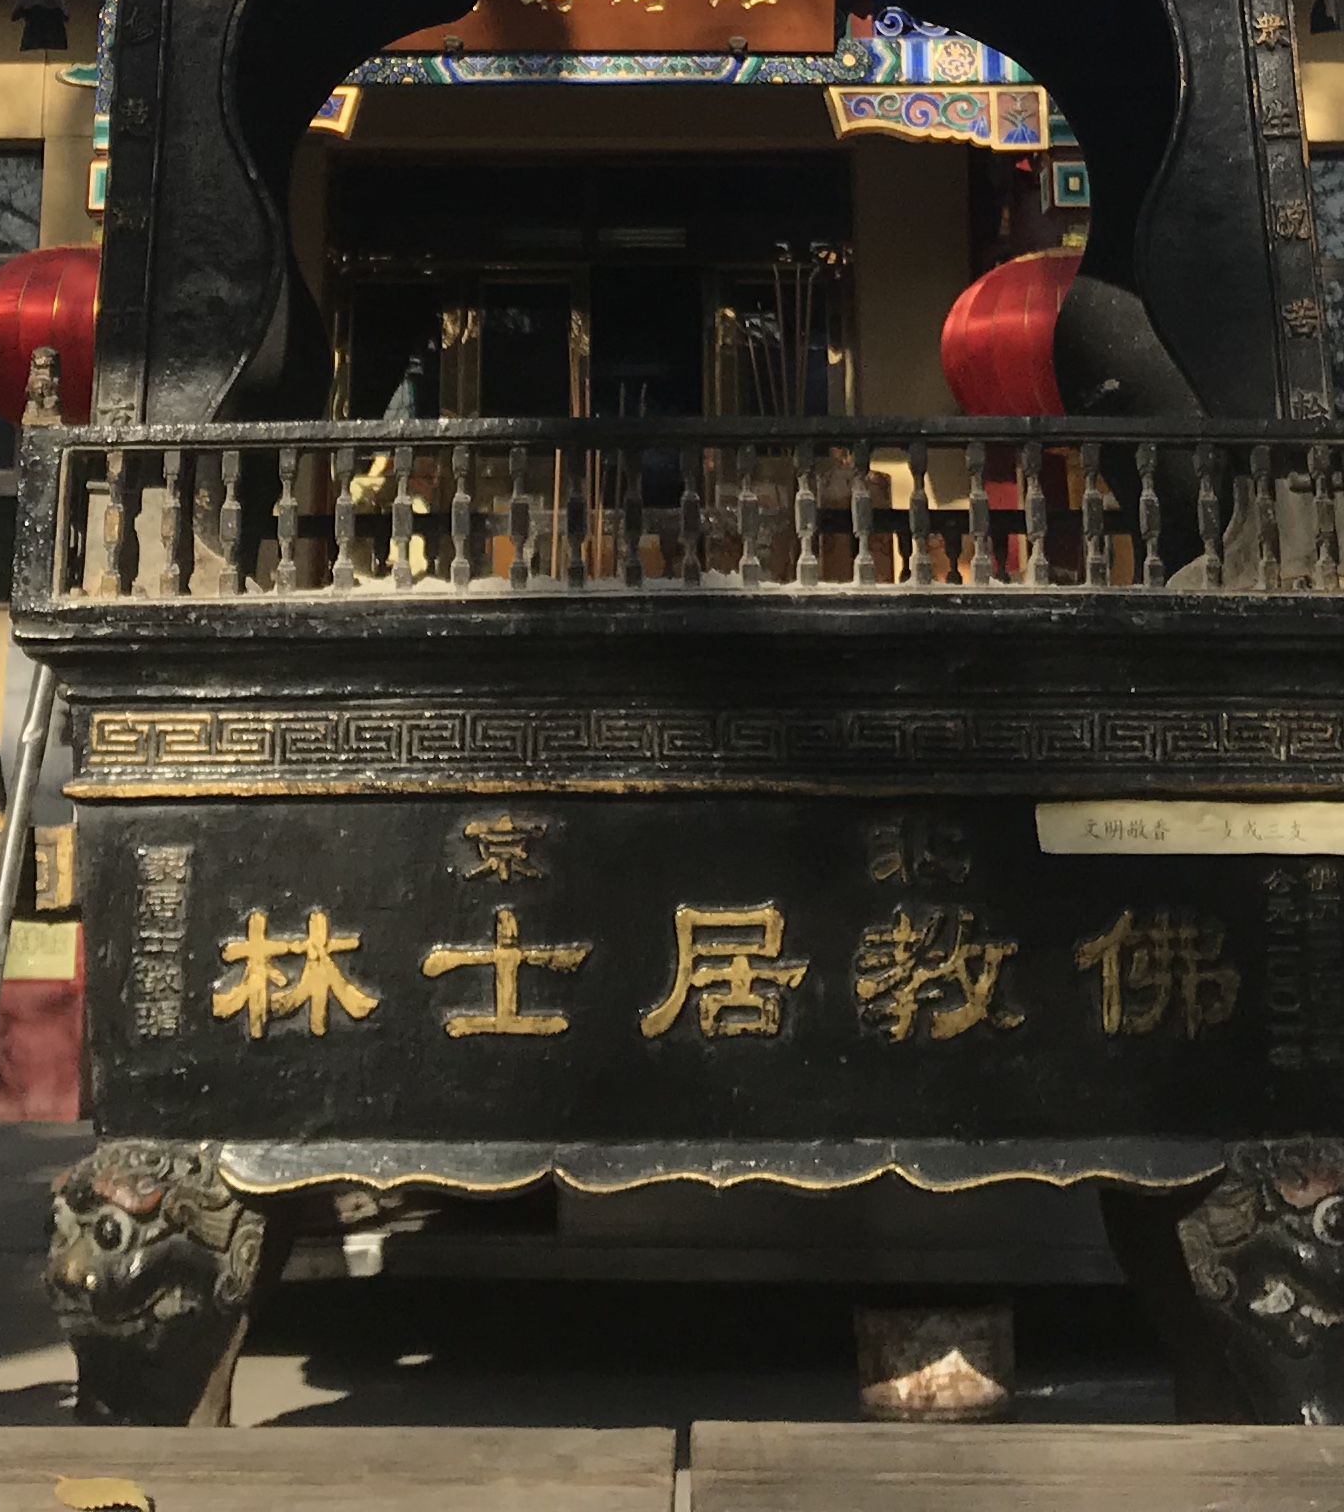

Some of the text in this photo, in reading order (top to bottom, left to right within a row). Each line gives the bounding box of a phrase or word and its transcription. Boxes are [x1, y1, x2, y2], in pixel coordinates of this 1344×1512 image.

[1080, 818, 1171, 843] 文明敬香
[213, 901, 1242, 1041] 佛教居士林
